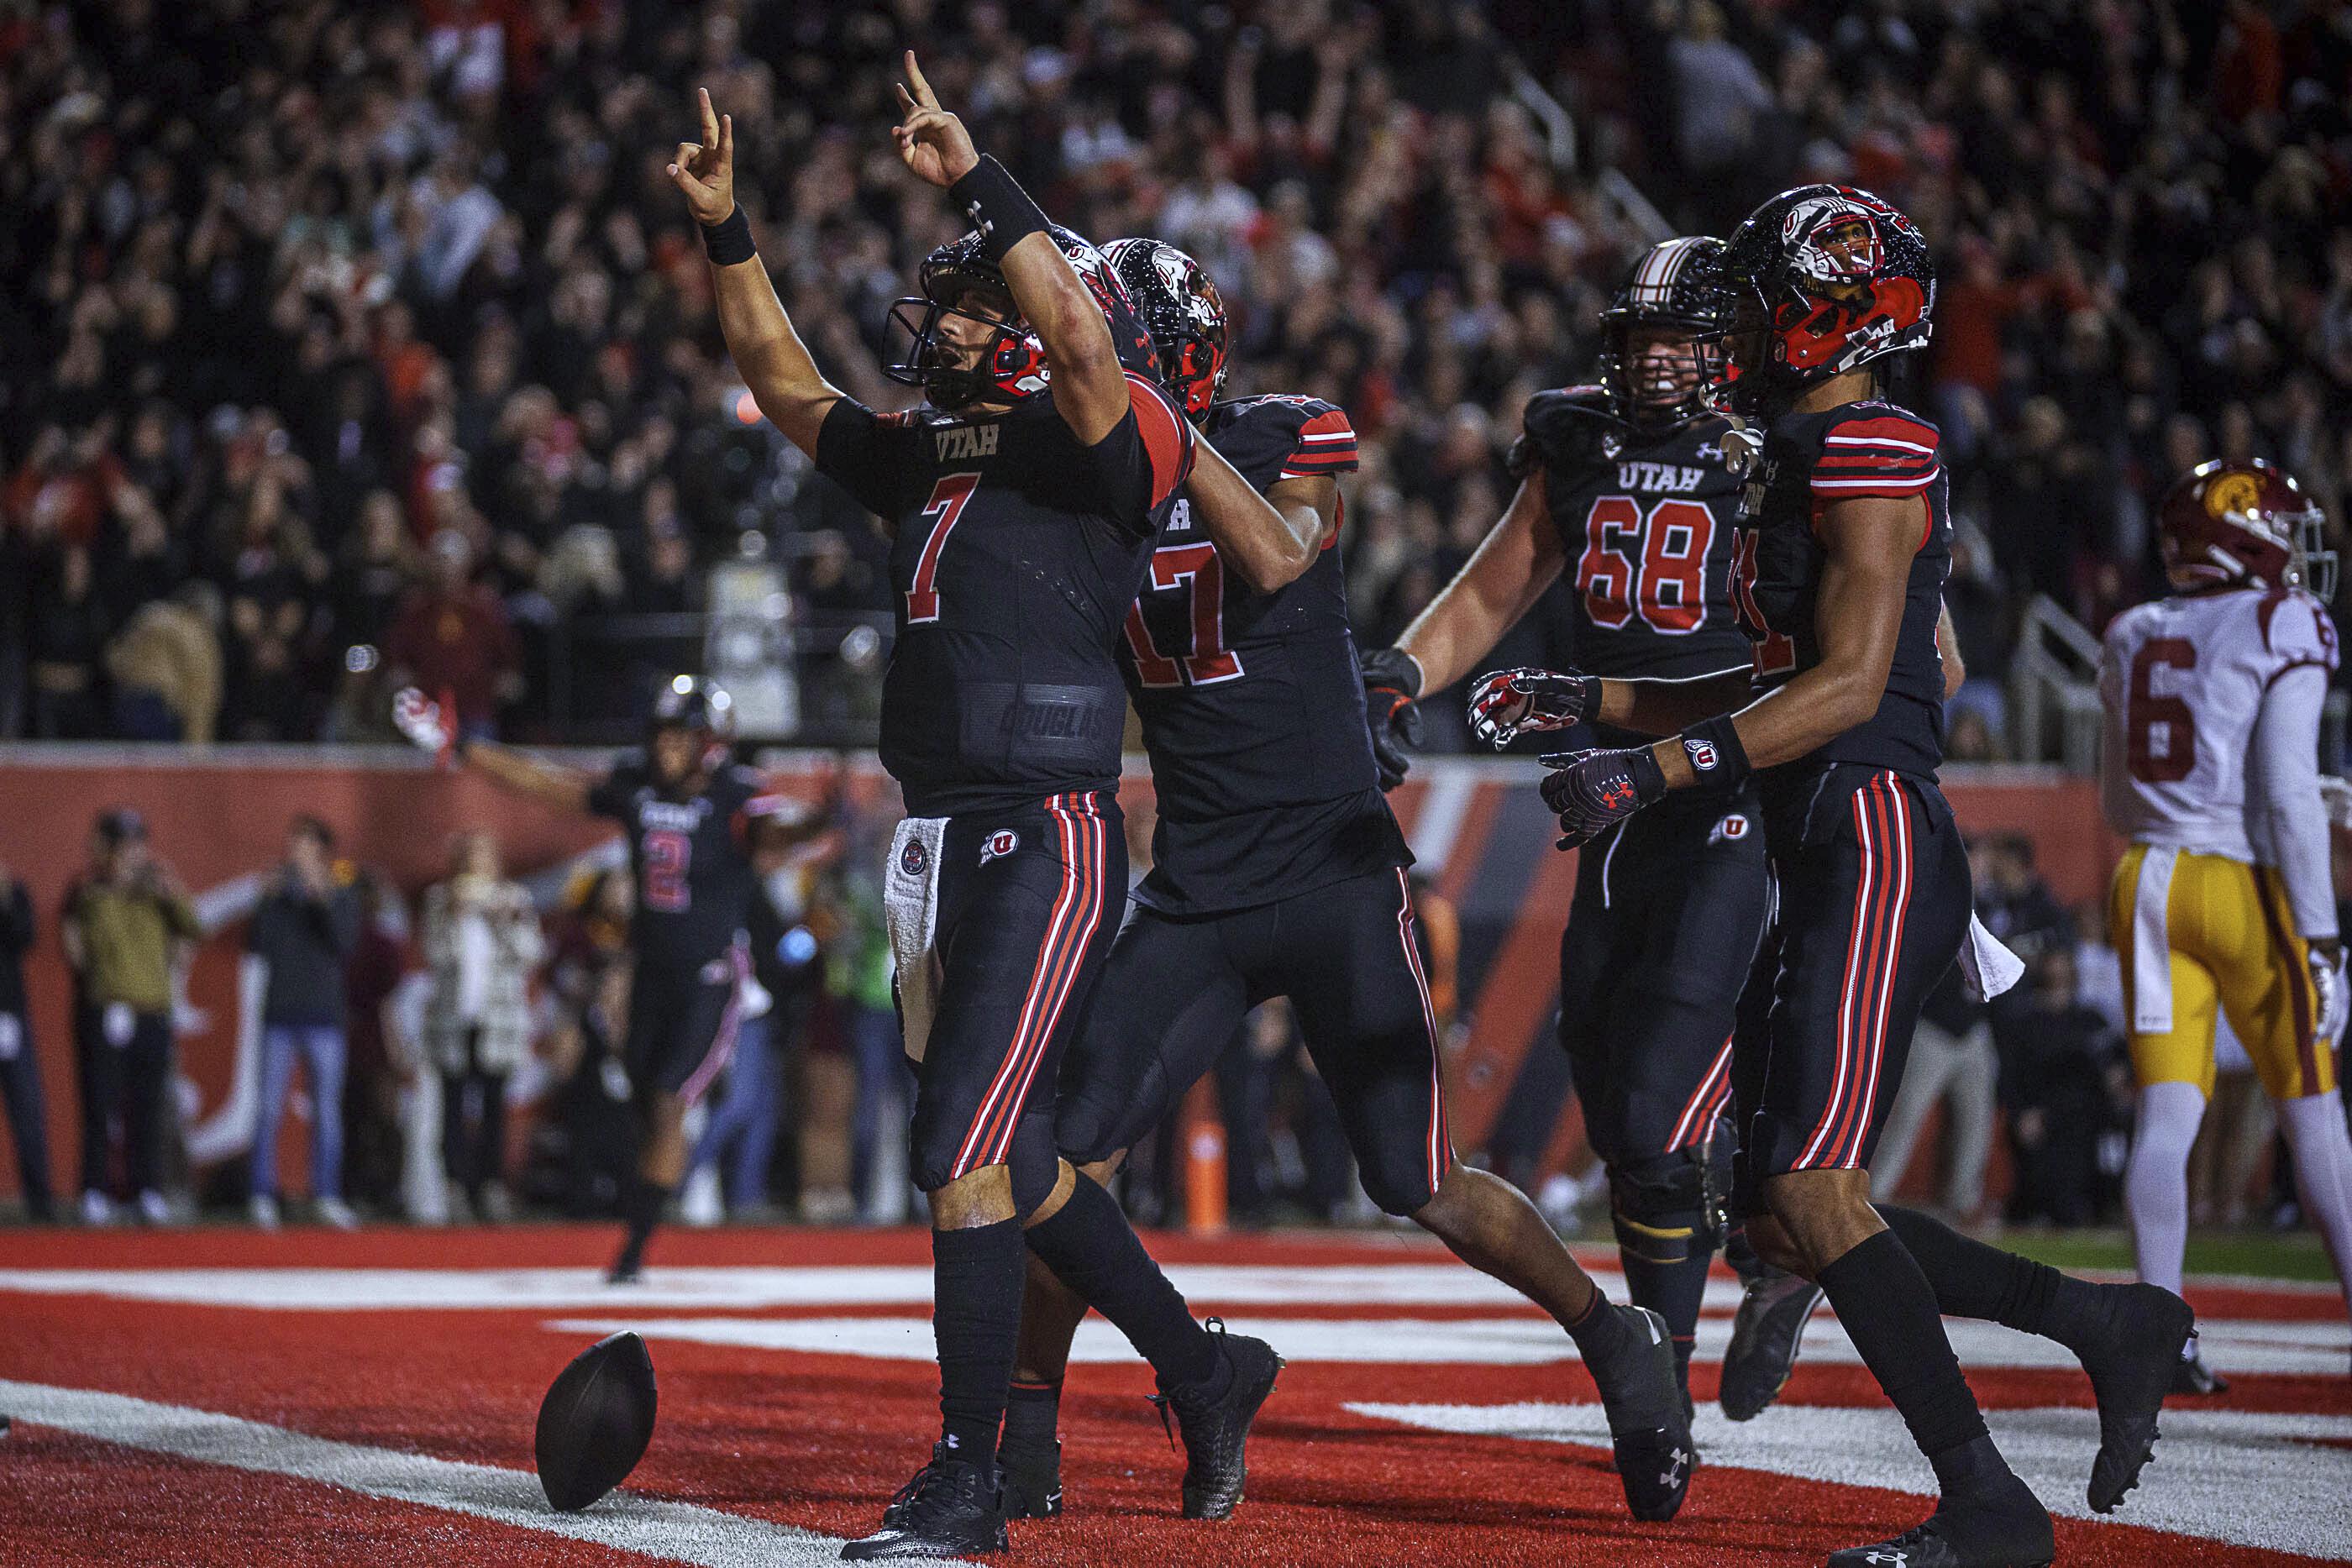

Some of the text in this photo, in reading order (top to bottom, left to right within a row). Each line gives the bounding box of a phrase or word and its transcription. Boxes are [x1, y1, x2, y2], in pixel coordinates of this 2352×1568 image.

[1616, 460, 1705, 493] UTAH
[904, 471, 982, 624] 7
[1575, 495, 1717, 636] 68
[2128, 637, 2196, 783] 6
[641, 829, 692, 914] 2
